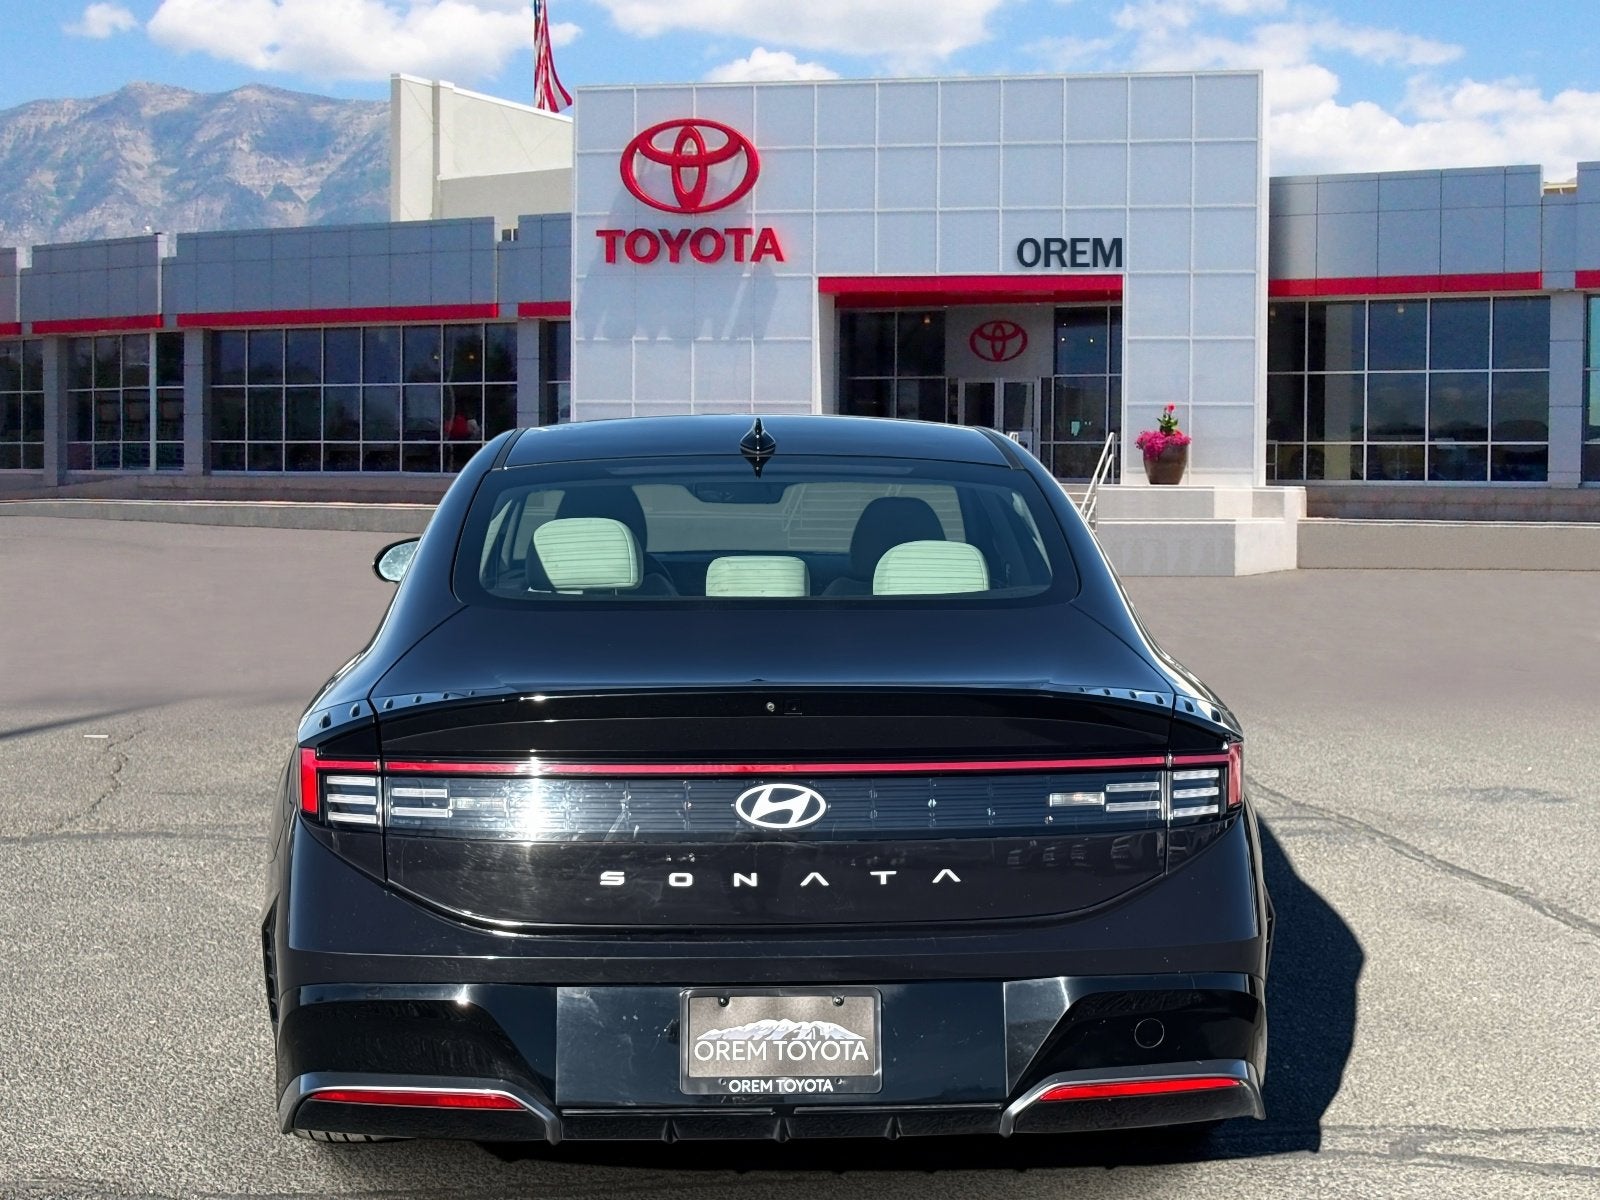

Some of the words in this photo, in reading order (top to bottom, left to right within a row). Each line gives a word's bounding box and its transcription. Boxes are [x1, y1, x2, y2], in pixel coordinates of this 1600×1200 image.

[596, 227, 785, 265] TOYOTA
[1016, 237, 1123, 268] OREM
[599, 868, 961, 888] SONATA
[694, 1040, 767, 1061] OREM
[773, 1040, 869, 1061] TOYOTA
[728, 1079, 773, 1093] OREM
[775, 1078, 834, 1093] TOYOTA
